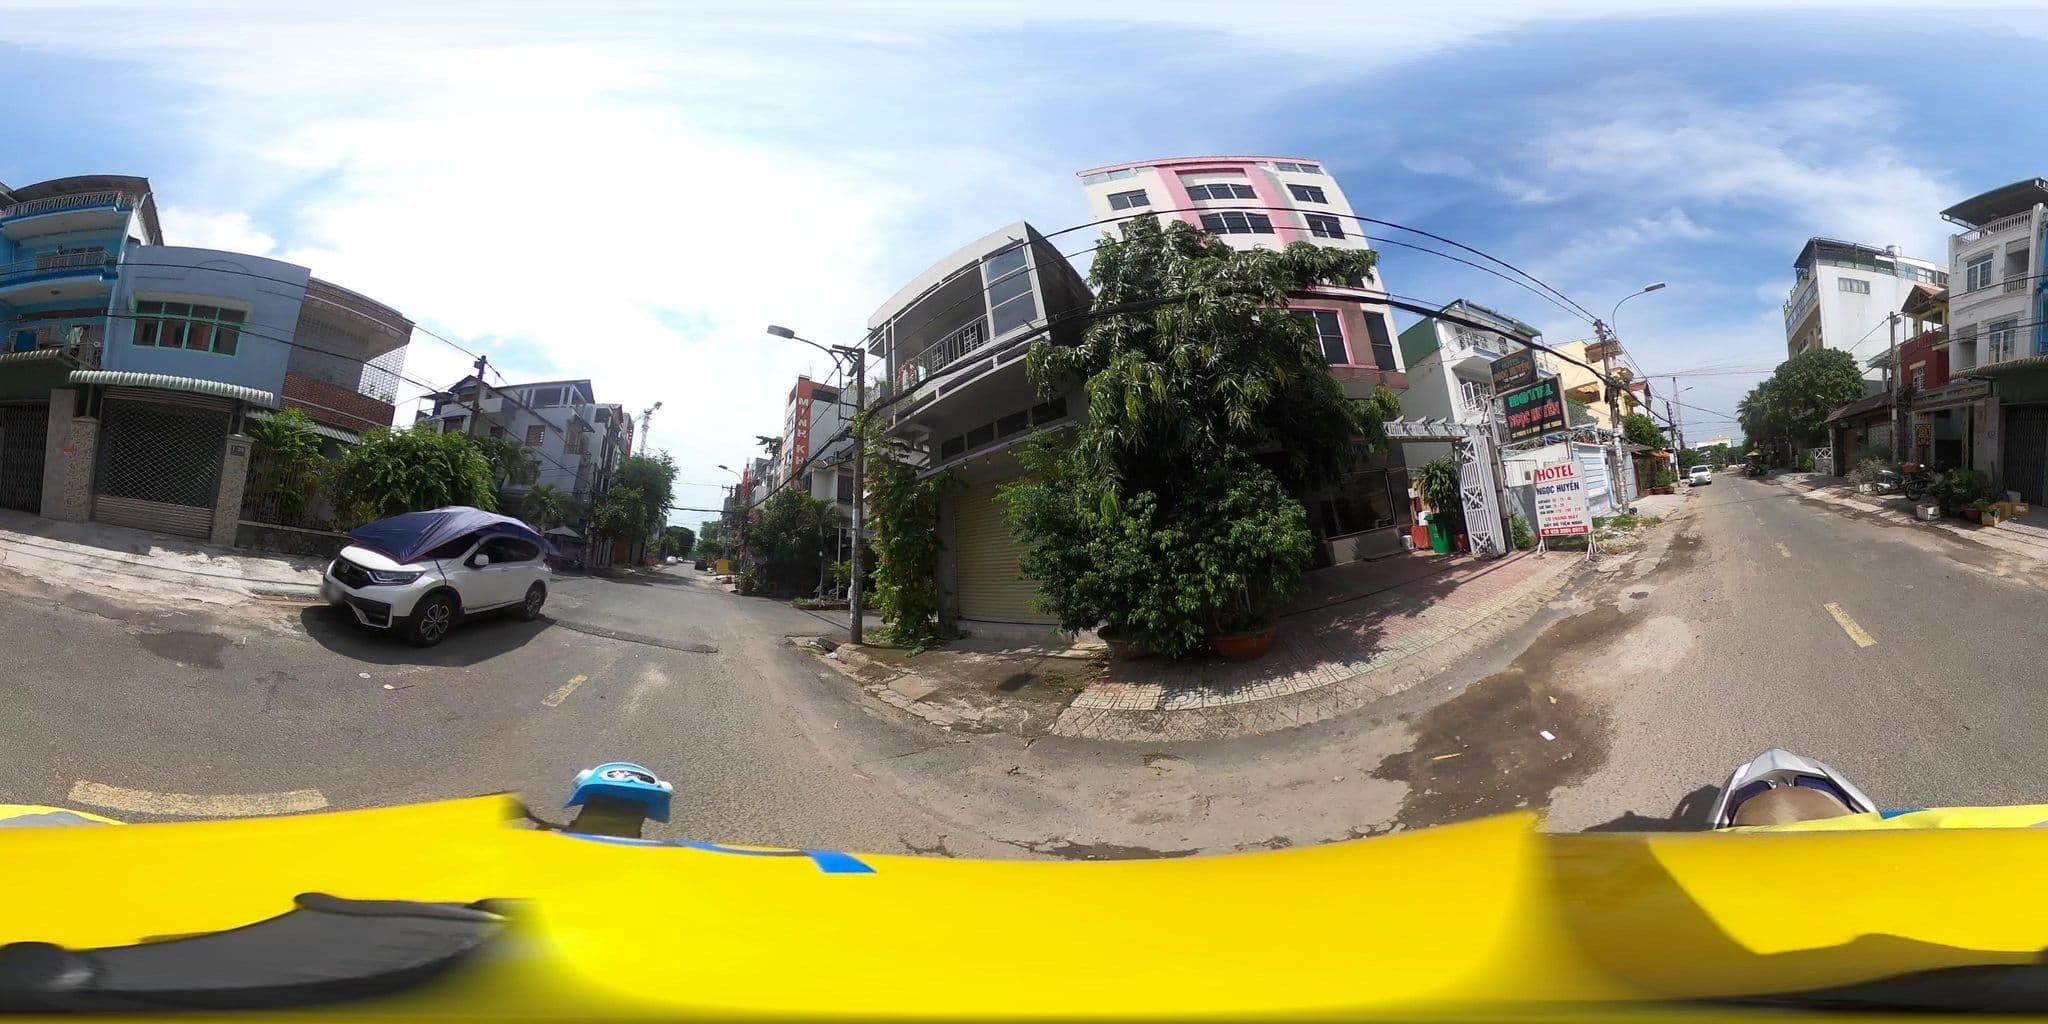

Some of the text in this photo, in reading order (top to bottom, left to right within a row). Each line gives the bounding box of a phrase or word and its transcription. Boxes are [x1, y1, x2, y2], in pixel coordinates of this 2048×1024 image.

[1508, 384, 1553, 408] HOTEL
[1537, 465, 1574, 480] HOTEL
[1536, 486, 1555, 496] NGỌC
